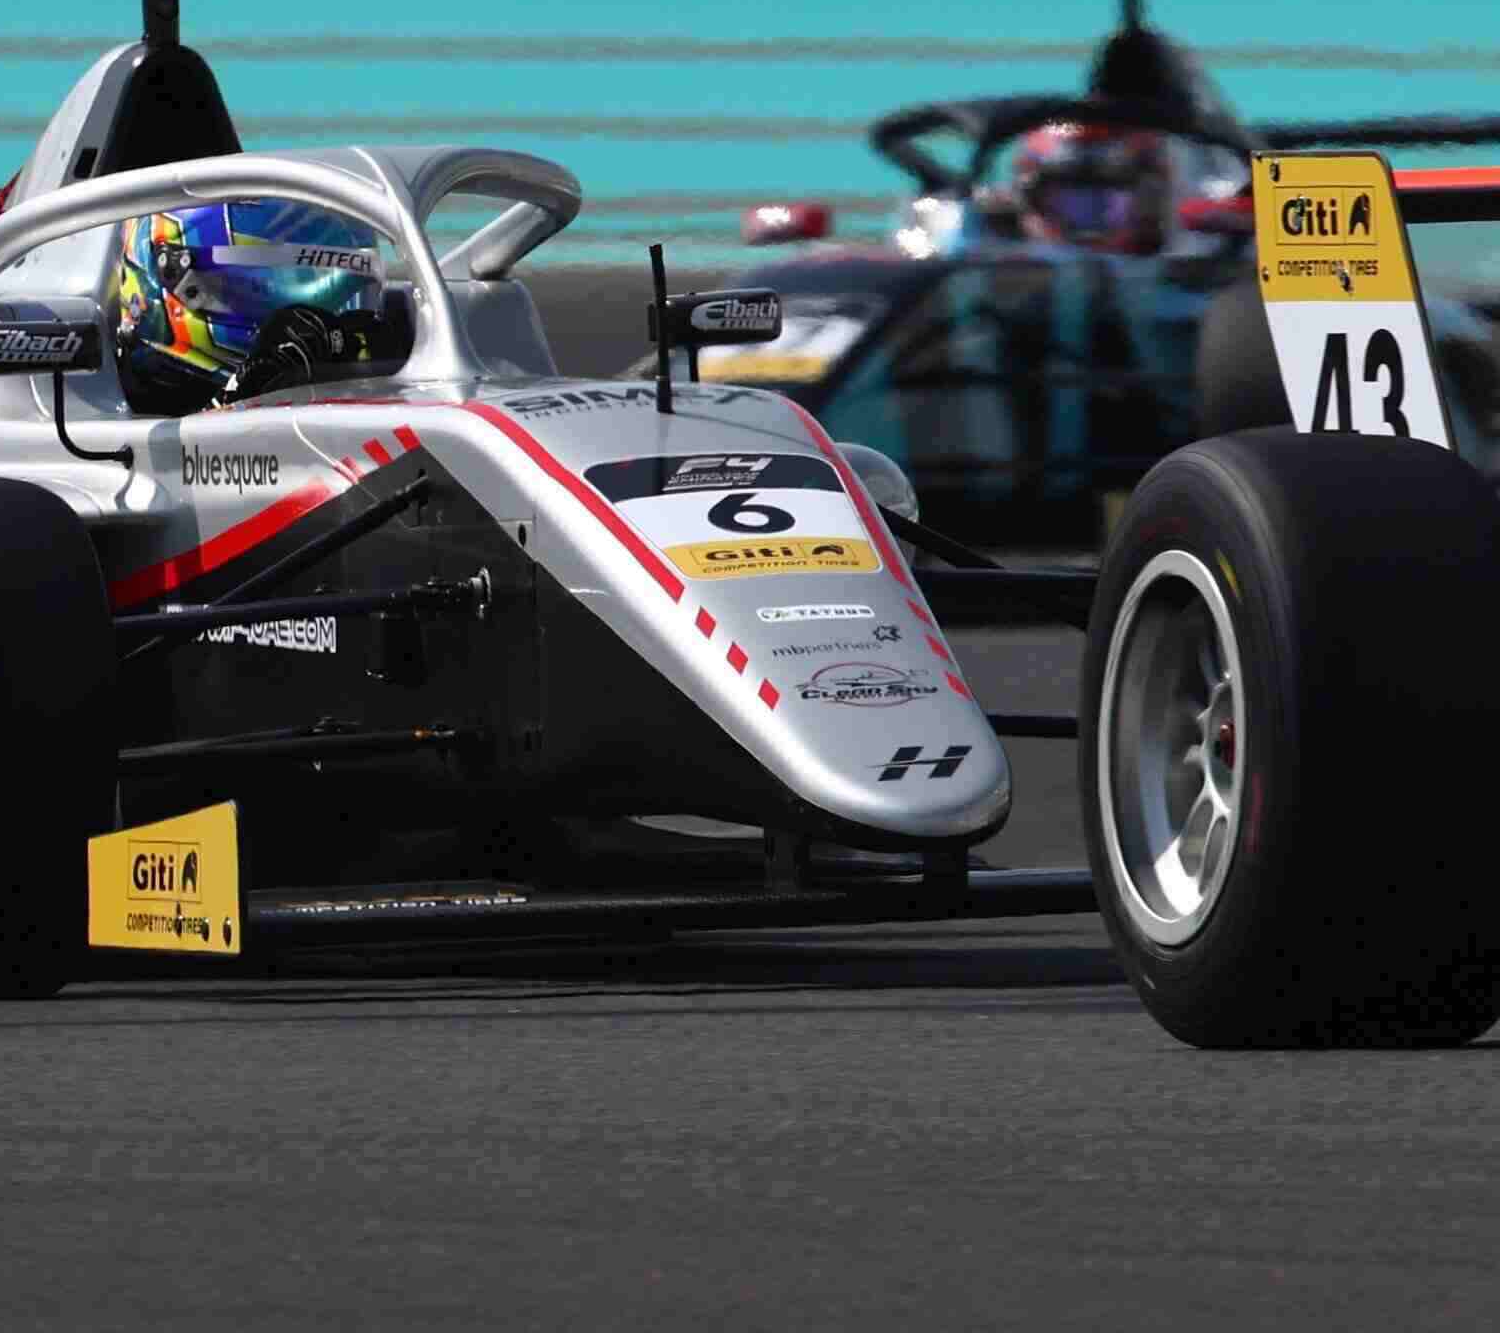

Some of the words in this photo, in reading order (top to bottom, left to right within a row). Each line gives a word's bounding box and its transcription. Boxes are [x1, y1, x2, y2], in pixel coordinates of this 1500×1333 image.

[297, 248, 371, 273] HITECH
[1310, 327, 1414, 439] 43
[182, 443, 221, 486] blue
[223, 451, 279, 495] square
[675, 456, 773, 475] F4
[707, 492, 796, 534] 6
[704, 545, 794, 562] Giti
[702, 559, 808, 575] COMPETITION
[815, 558, 861, 568] TIRES
[771, 639, 884, 659] mbpartners
[132, 852, 175, 892] Giti
